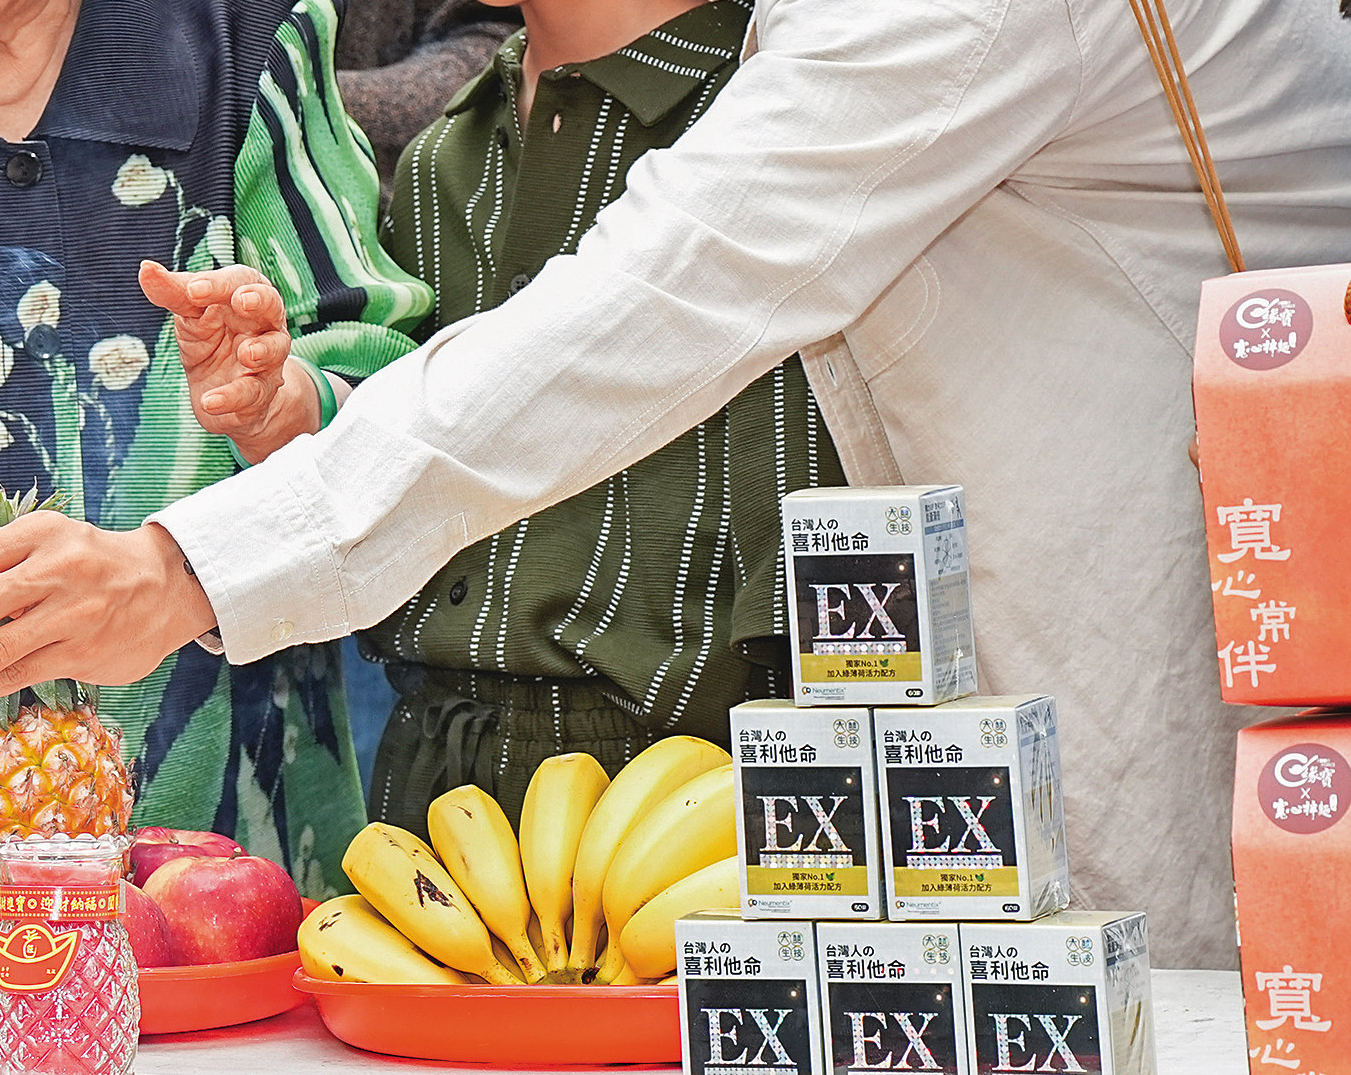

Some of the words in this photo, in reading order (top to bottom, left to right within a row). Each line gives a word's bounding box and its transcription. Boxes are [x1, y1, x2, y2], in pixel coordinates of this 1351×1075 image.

[791, 518, 839, 532] 台灣人の
[791, 532, 869, 552] 喜利他命
[809, 583, 905, 639] EX
[739, 729, 786, 742] 台灣人の
[884, 729, 932, 743] 台灣人の
[739, 744, 817, 763] 喜利他命
[884, 744, 963, 764] 喜利他命
[756, 795, 852, 852] EX
[902, 796, 1001, 853] EX
[684, 941, 731, 955] 台灣人の
[826, 944, 875, 958] 台灣人の
[969, 945, 1018, 959] 台灣人の
[684, 956, 761, 976] 喜利他命
[826, 959, 906, 980] 喜利他命
[970, 960, 1049, 981] 喜利他命
[1249, 964, 1333, 1075] 寬心
[700, 1008, 798, 1065] EX
[843, 1012, 943, 1069] EX
[988, 1013, 1088, 1073] EX
